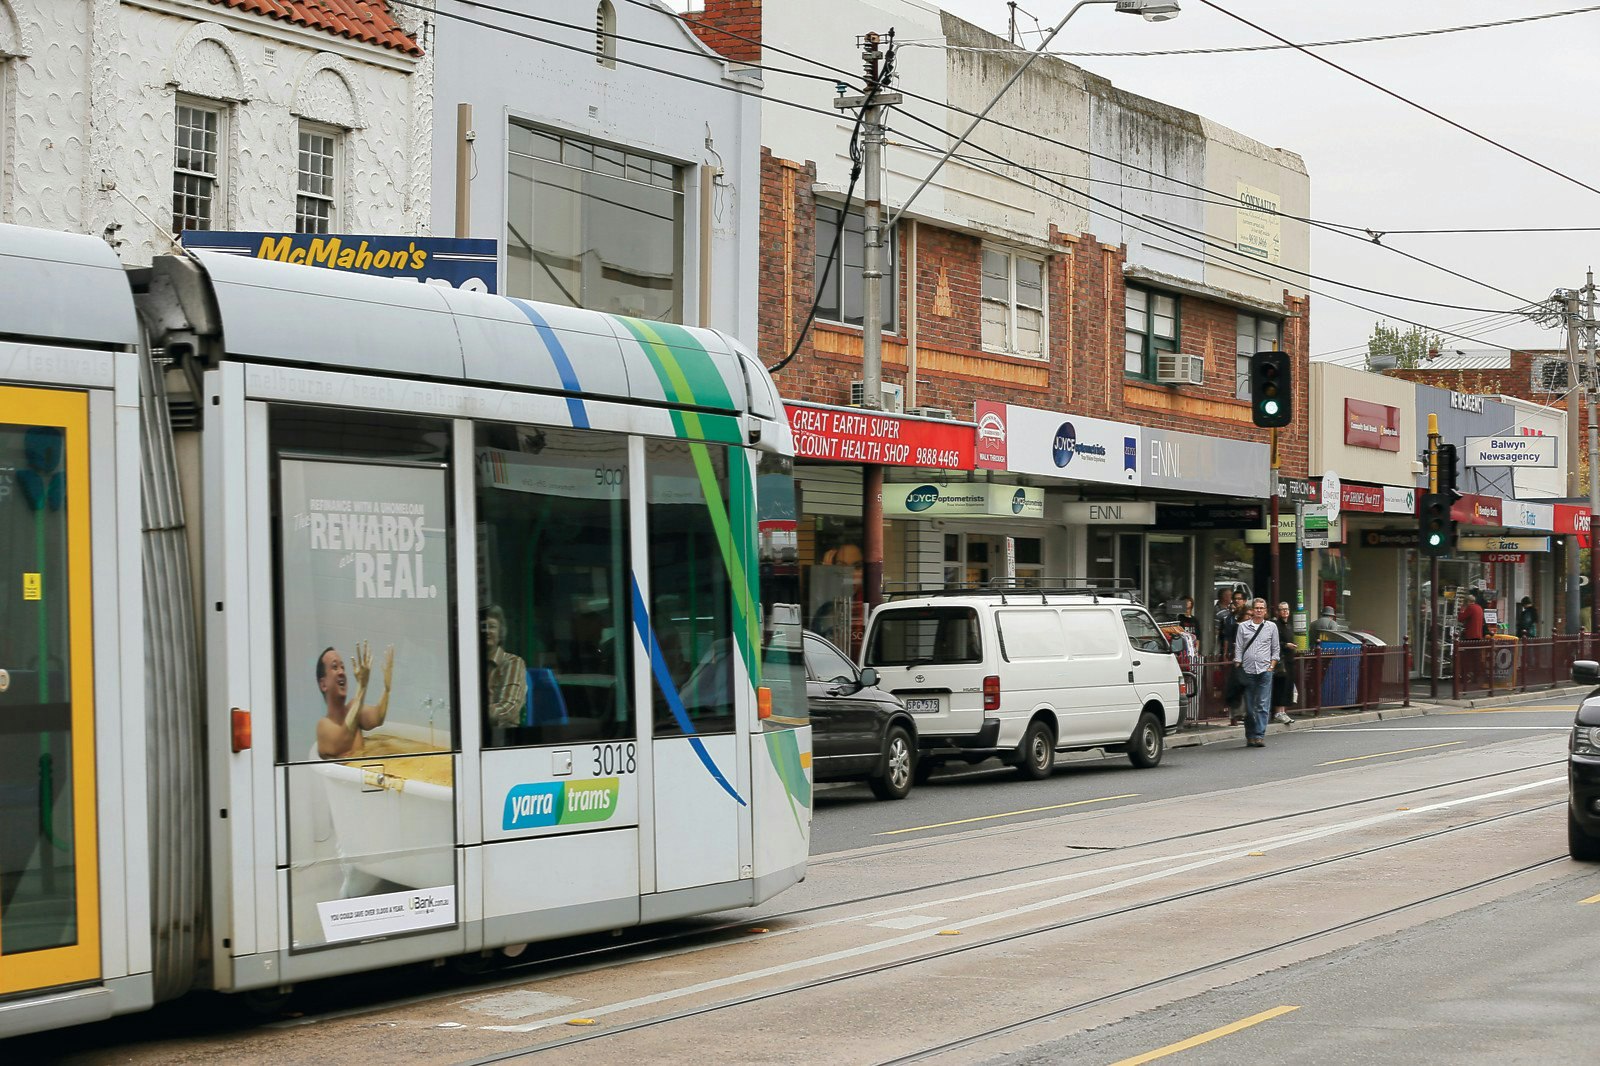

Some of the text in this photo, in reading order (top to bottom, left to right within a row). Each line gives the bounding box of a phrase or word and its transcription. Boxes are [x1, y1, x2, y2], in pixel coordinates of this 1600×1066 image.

[257, 236, 428, 270] McMahon's
[1450, 391, 1485, 415] NEWSAGENCY
[793, 409, 900, 439] GREAT EARTH SUPER
[792, 434, 959, 467] SCOUNT HEALTH SHOP 9888 4466
[1053, 436, 1076, 452] JOYCE
[1479, 440, 1540, 462] Balwyn Newsagency
[979, 453, 1006, 463] WALK THROUGH
[309, 499, 352, 512] REFINANCE
[353, 501, 373, 513] WITH
[373, 502, 380, 513] A
[907, 493, 985, 503] JOYCE optometrists
[1342, 491, 1350, 502] For
[1349, 492, 1365, 504] SHOES
[1365, 494, 1373, 504] that
[1372, 494, 1381, 505] FIT
[1526, 510, 1537, 526] Tatts
[310, 512, 425, 552] REWARDS
[1498, 541, 1519, 550] Tatts
[1497, 554, 1521, 562] POST
[355, 552, 437, 599] REAL.
[925, 700, 938, 709] 575
[592, 742, 637, 777] 3018
[511, 788, 611, 824] yarra trams
[365, 909, 375, 917] OVER
